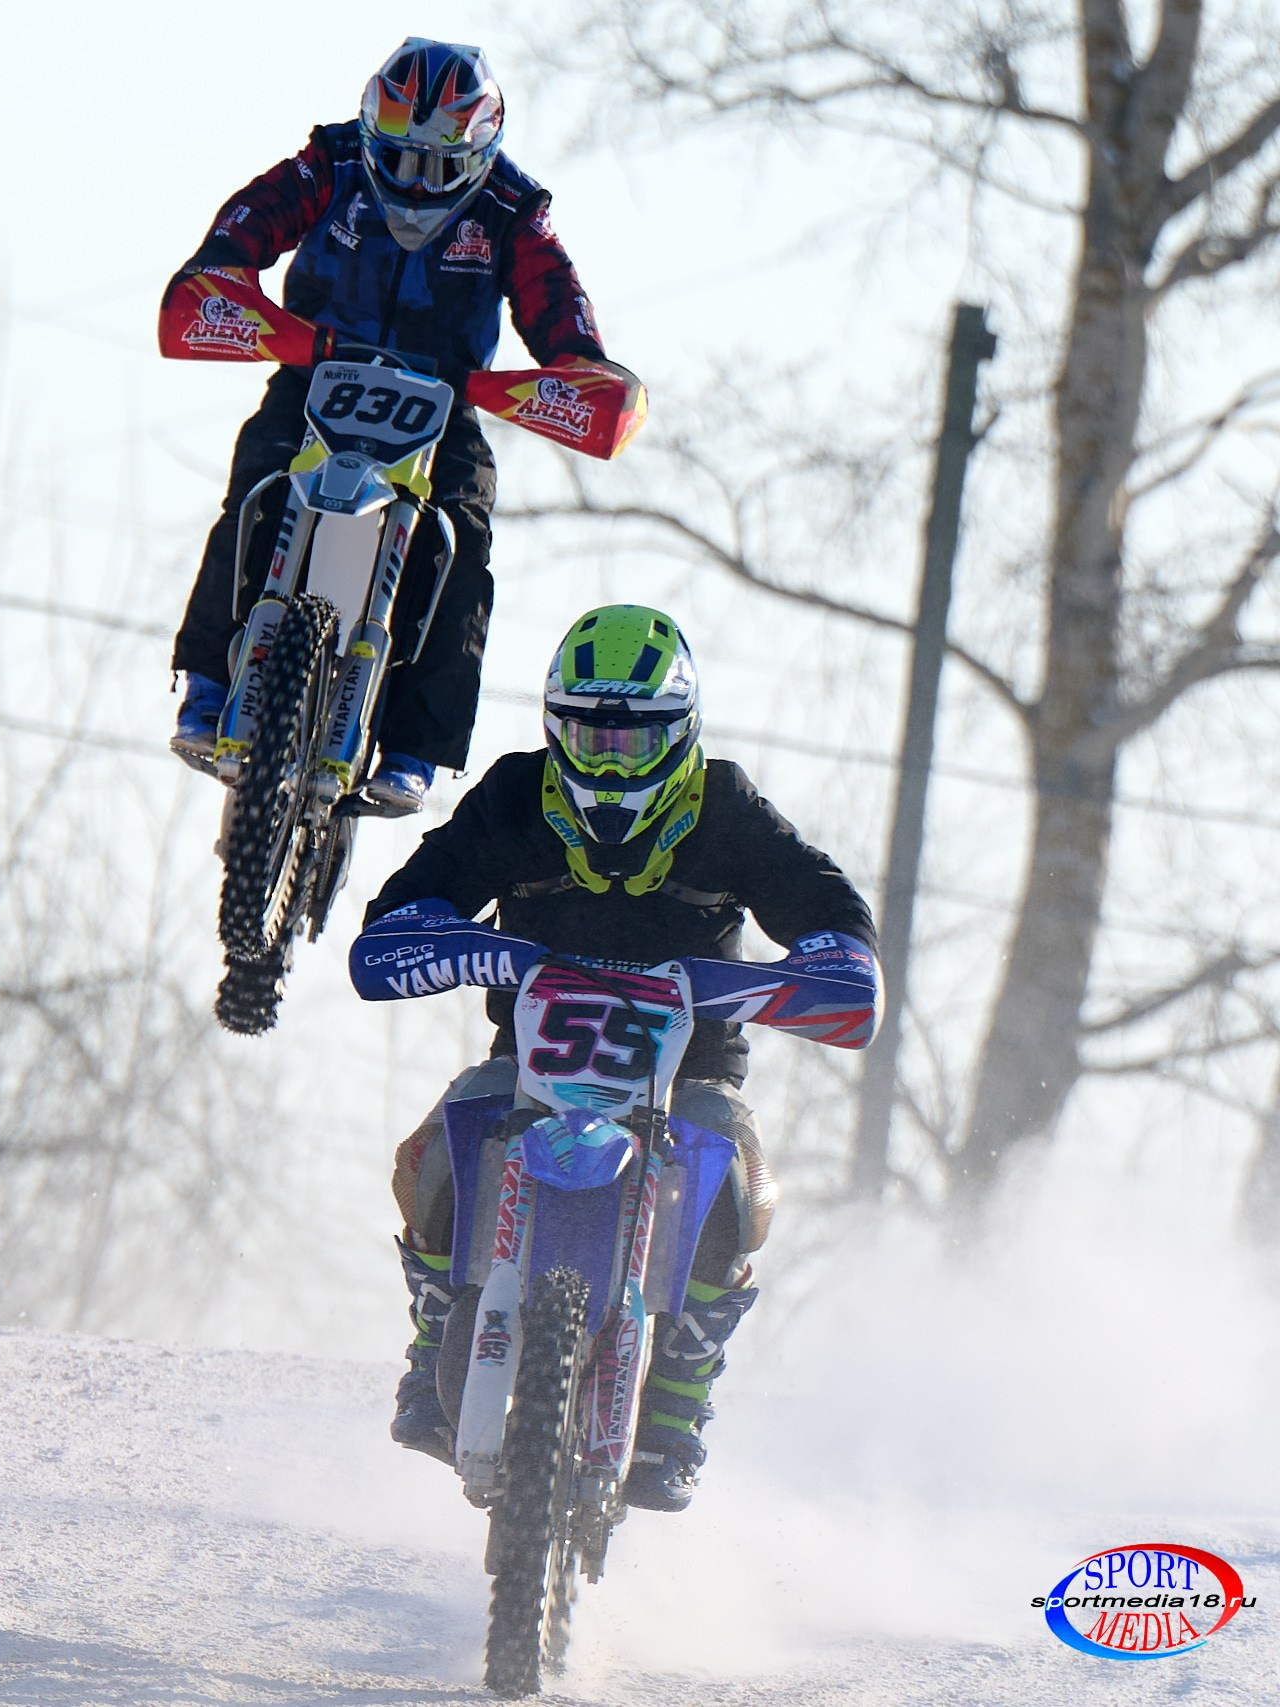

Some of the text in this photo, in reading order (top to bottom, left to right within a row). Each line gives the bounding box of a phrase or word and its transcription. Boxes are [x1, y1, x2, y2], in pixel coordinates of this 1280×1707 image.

[182, 320, 258, 348] ARENA
[320, 383, 437, 435] 830
[516, 398, 591, 435] ARENA
[329, 665, 362, 747] ТАТАРСТАН
[571, 679, 651, 695] LEATT
[365, 943, 435, 967] GoPro
[385, 951, 520, 998] YAMAHA
[528, 1001, 673, 1085] 55
